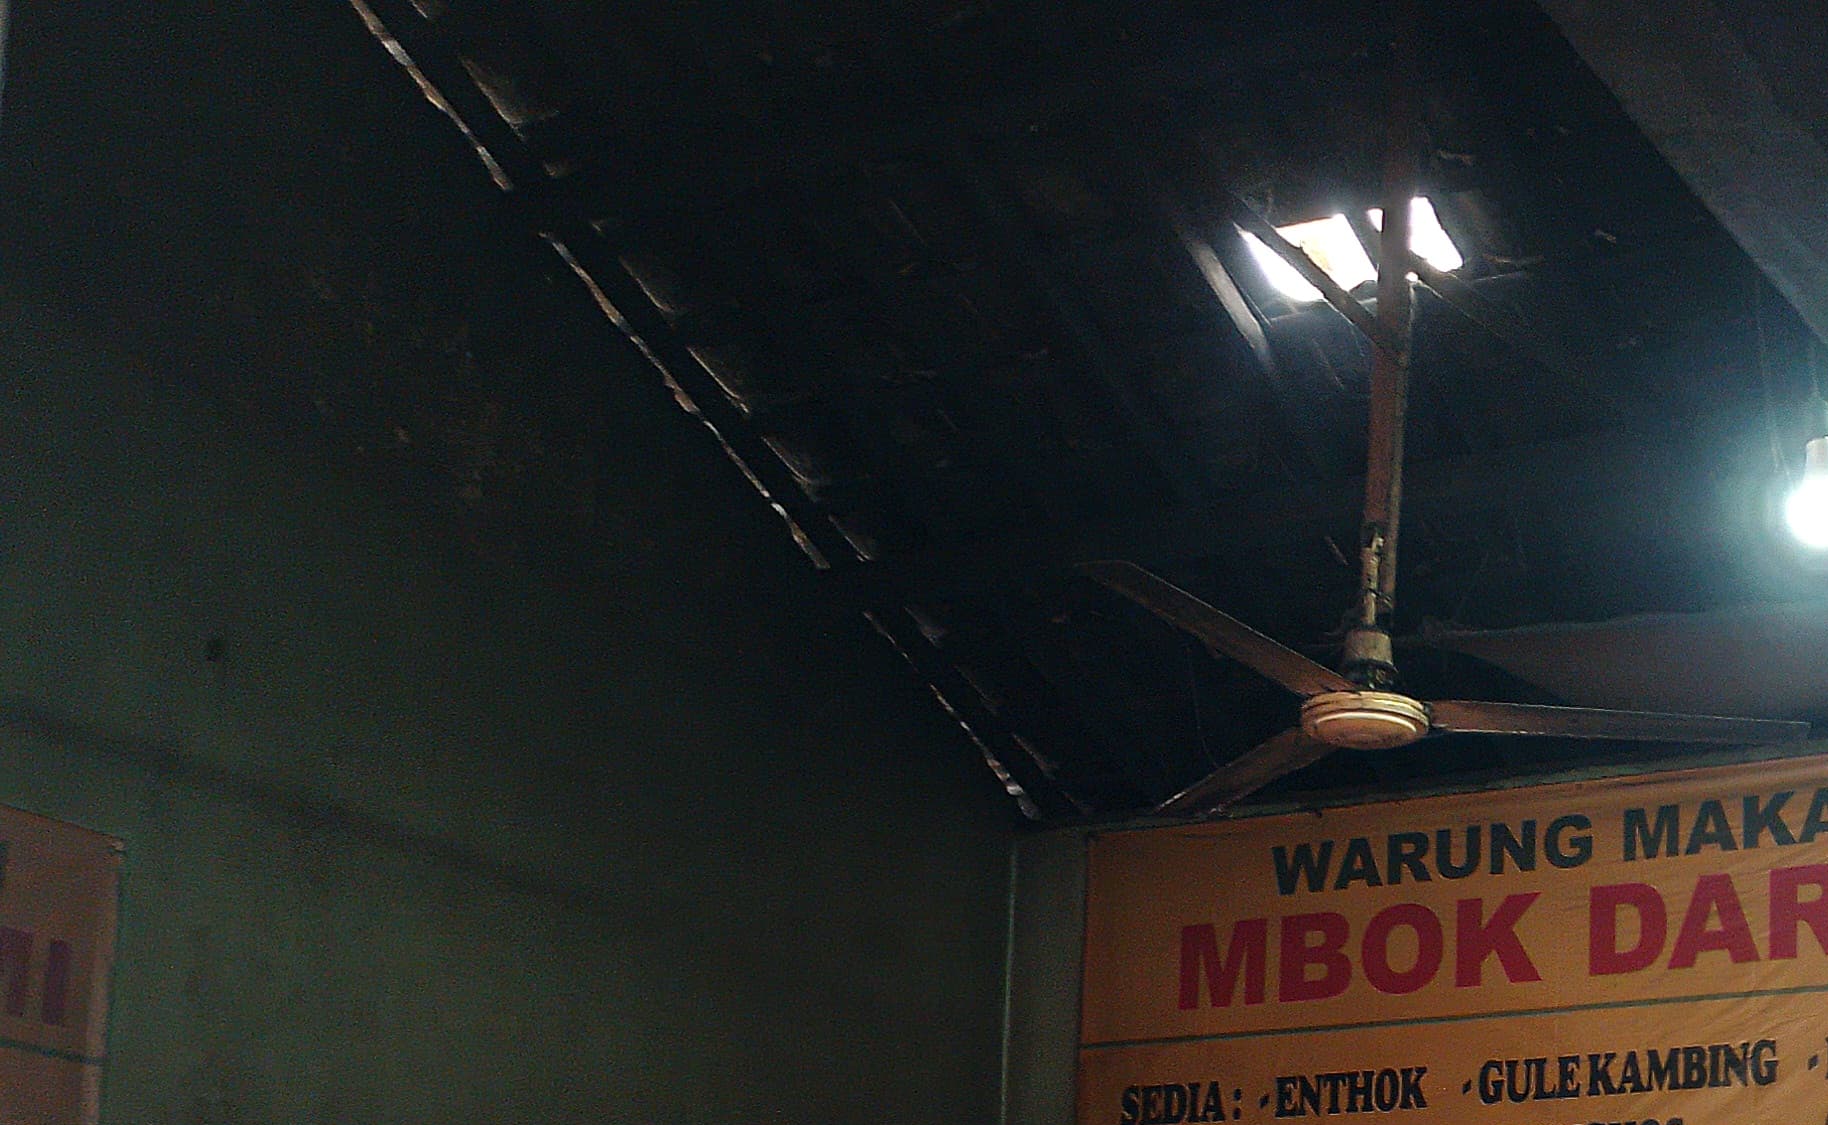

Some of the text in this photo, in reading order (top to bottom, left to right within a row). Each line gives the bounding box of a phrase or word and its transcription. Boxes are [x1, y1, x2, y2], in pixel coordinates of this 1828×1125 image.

[1271, 813, 1594, 896] WARUNG
[1177, 891, 1543, 1011] MBOK
[1275, 1066, 1428, 1120] ENTHOK
